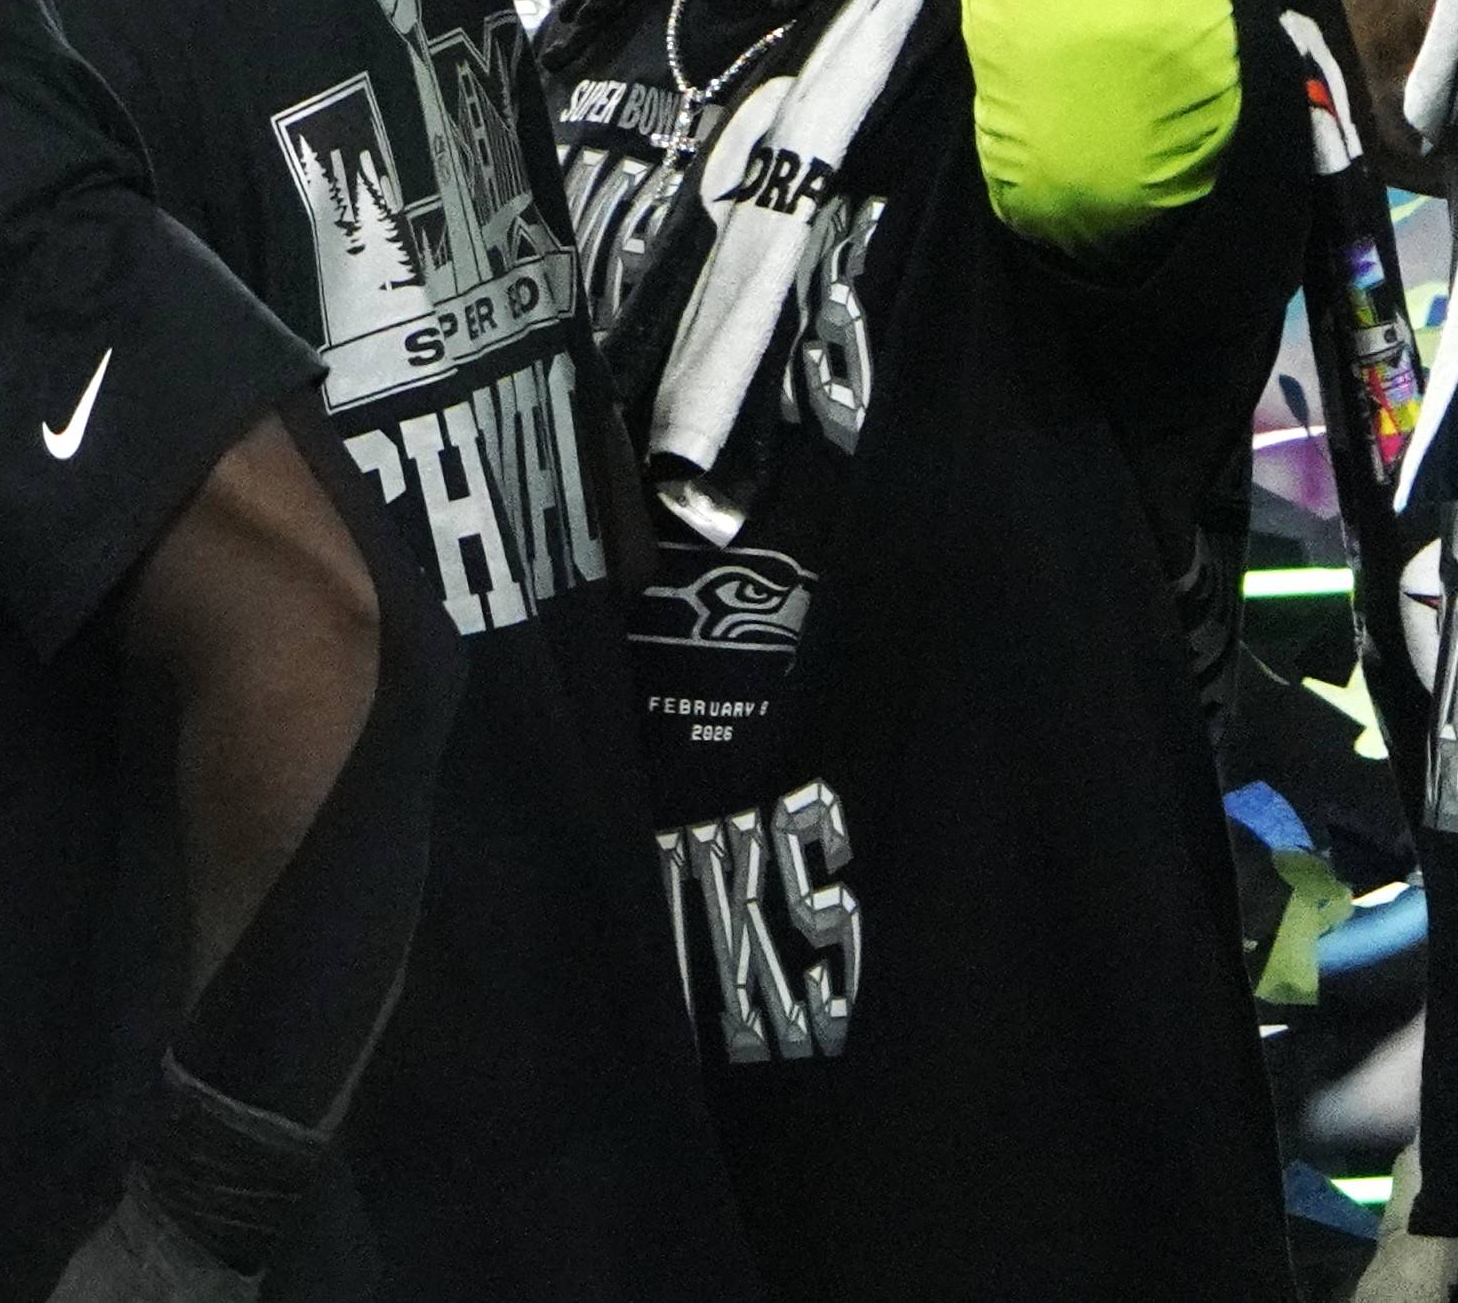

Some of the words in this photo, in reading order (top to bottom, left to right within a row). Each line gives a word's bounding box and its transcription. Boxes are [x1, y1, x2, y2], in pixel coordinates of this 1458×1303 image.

[558, 77, 627, 124] SUPER
[617, 81, 681, 138] BOW
[403, 292, 499, 370] SPER
[648, 696, 756, 718] FEBRUARY
[690, 723, 734, 742] 2026
